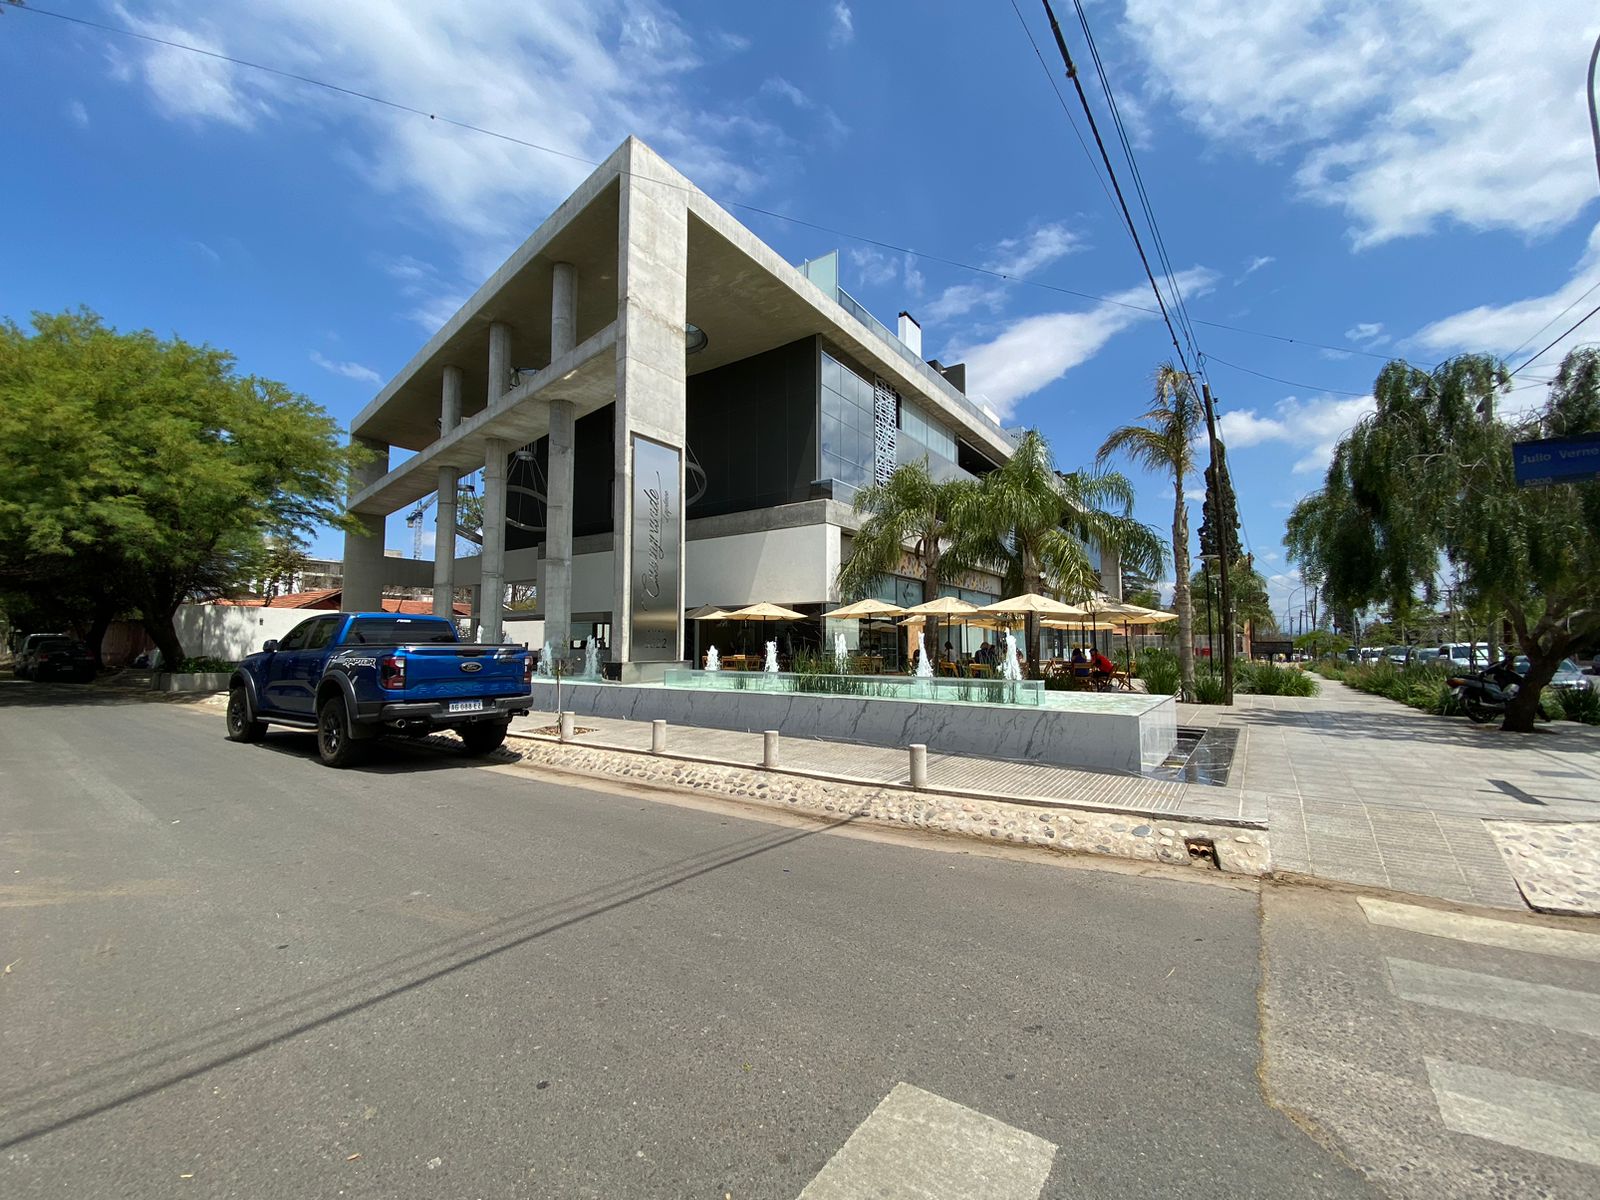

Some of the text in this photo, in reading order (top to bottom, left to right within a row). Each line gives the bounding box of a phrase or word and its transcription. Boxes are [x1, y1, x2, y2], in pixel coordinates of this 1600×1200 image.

[1520, 447, 1600, 464] Julio Verne
[641, 471, 664, 611] Casagrande
[343, 657, 377, 669] RAPTOR
